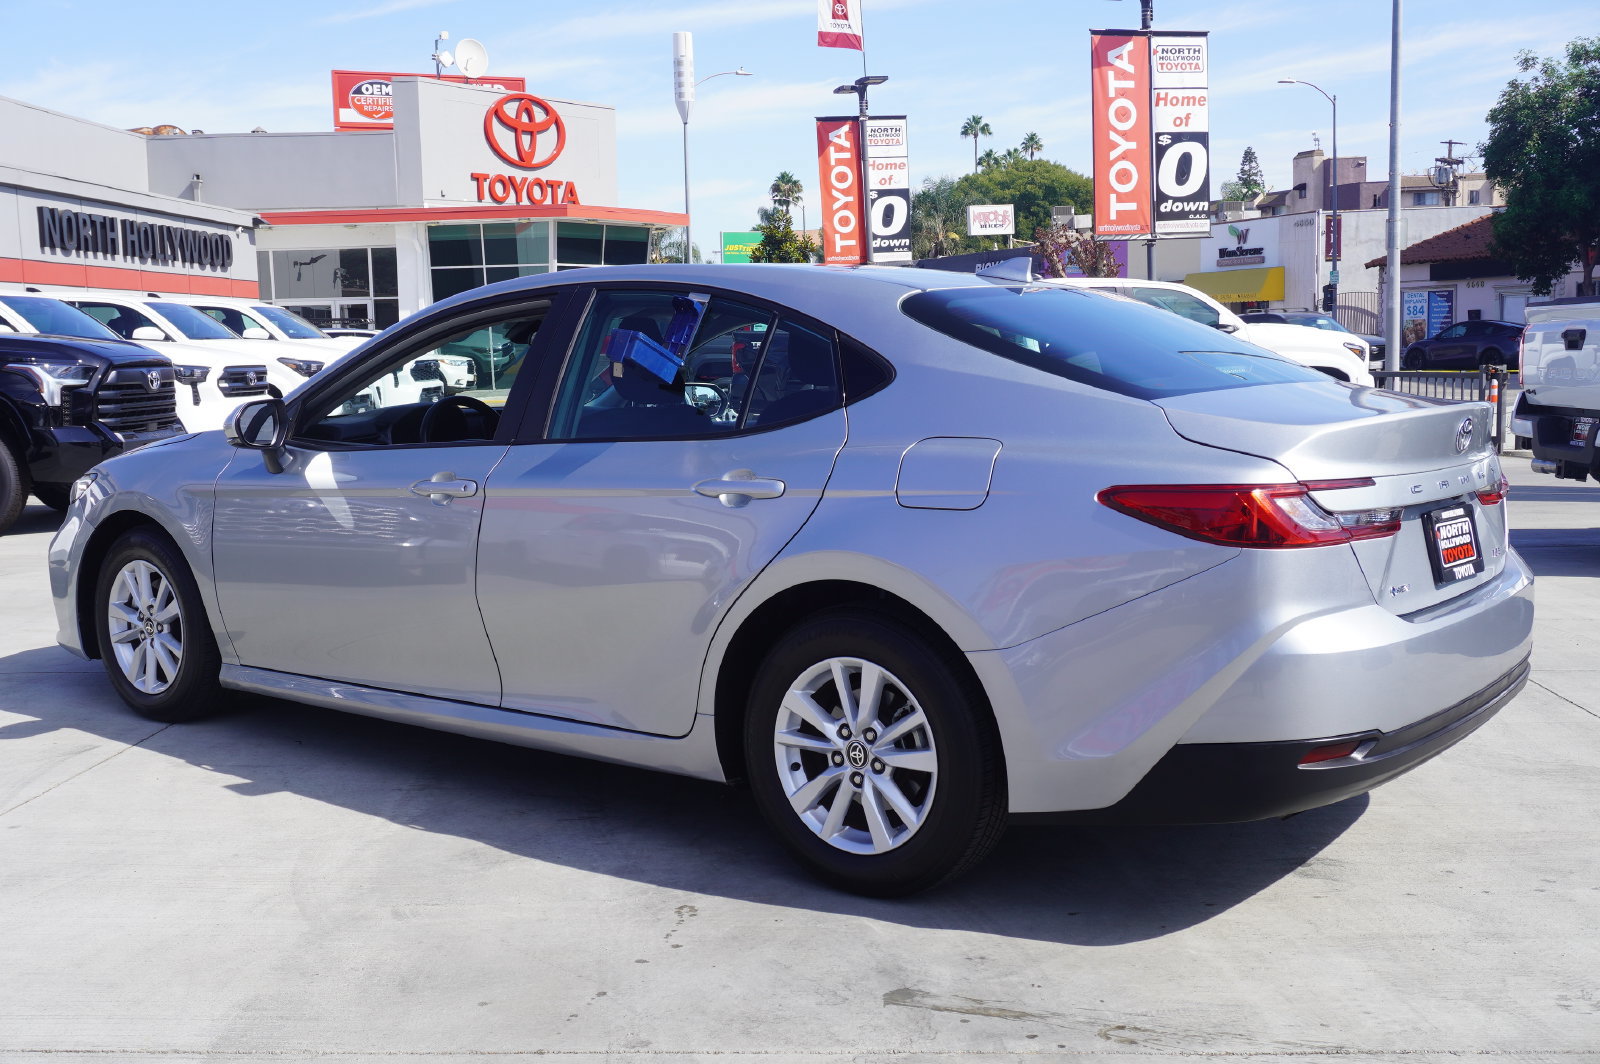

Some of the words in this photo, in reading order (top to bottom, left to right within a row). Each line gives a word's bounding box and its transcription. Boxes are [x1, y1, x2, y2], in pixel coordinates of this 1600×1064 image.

[829, 22, 852, 30] TOYOTA
[1161, 47, 1201, 55] NORTH
[1158, 62, 1201, 71] TOYOTA
[361, 83, 393, 95] OEM
[354, 96, 394, 105] CERTIFIE
[1155, 92, 1207, 107] Home
[1172, 113, 1192, 127] of
[1107, 41, 1139, 220] TOYOTA
[868, 160, 907, 171] Home
[878, 174, 894, 186] of
[471, 172, 581, 205] TOYOTA
[828, 123, 857, 253] TOYOTA
[1160, 200, 1209, 213] down
[37, 206, 120, 255] NORTH
[120, 218, 234, 268] HOLLYWOOD
[873, 238, 910, 248] down
[1406, 305, 1425, 316] $84
[1440, 521, 1470, 540] NORTH
[1442, 543, 1475, 564] TOYOTA
[1453, 563, 1475, 580] TOYOTA
